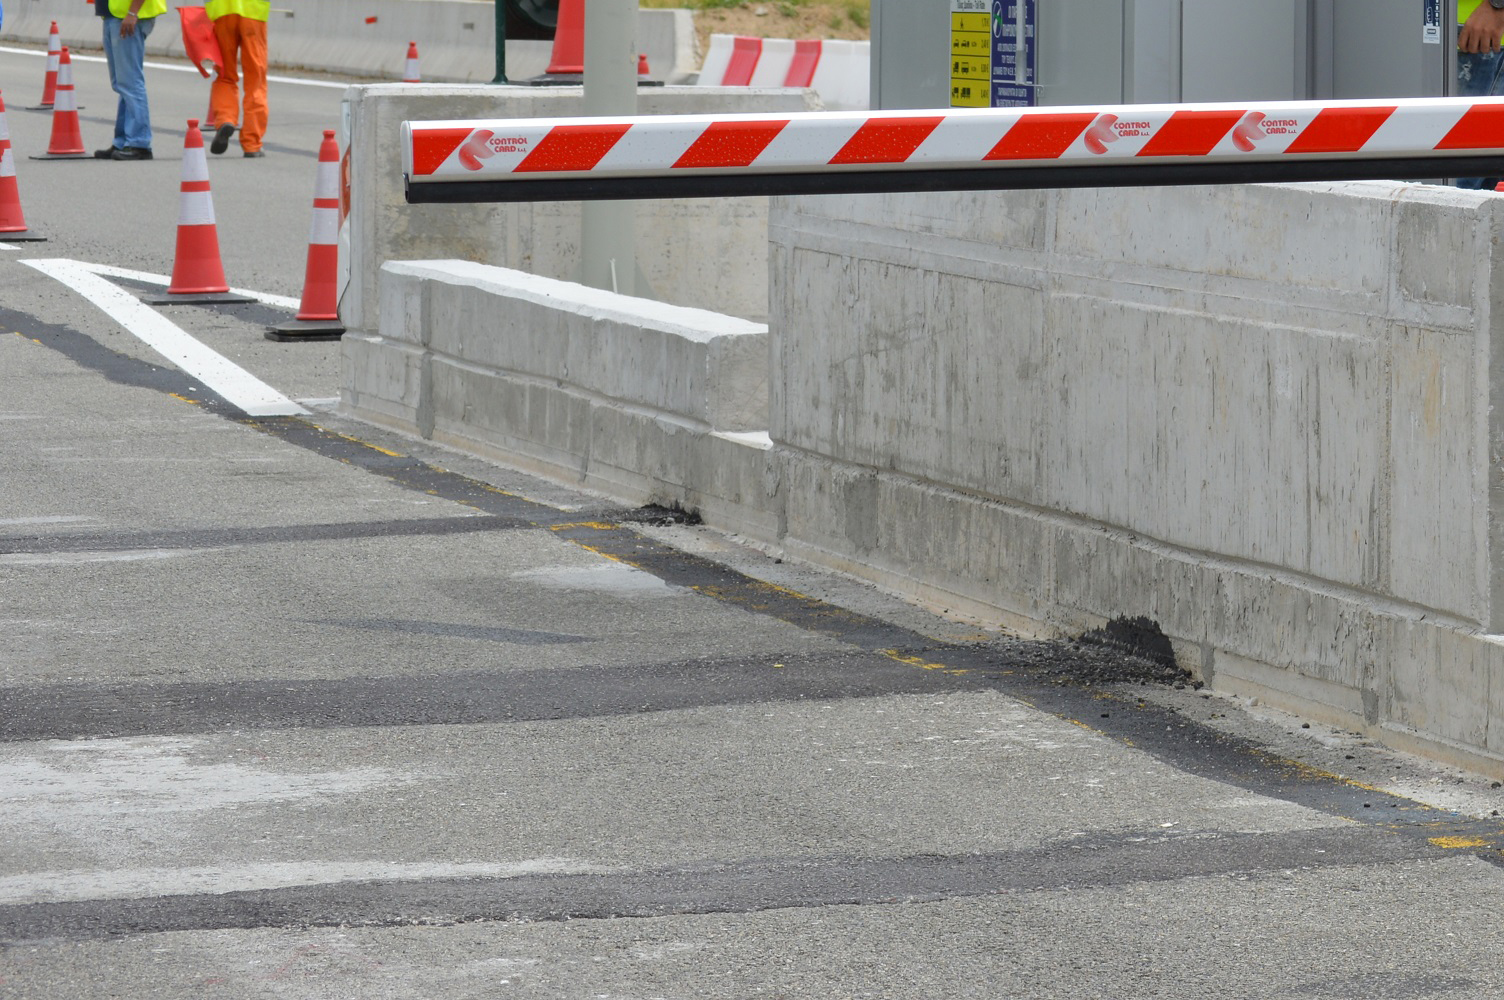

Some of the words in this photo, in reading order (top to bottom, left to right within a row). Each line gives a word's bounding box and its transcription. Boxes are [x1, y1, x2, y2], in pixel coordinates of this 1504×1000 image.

[1113, 121, 1151, 129] CONTROL
[1261, 119, 1298, 127] CONTROL
[489, 137, 528, 145] CONTROL
